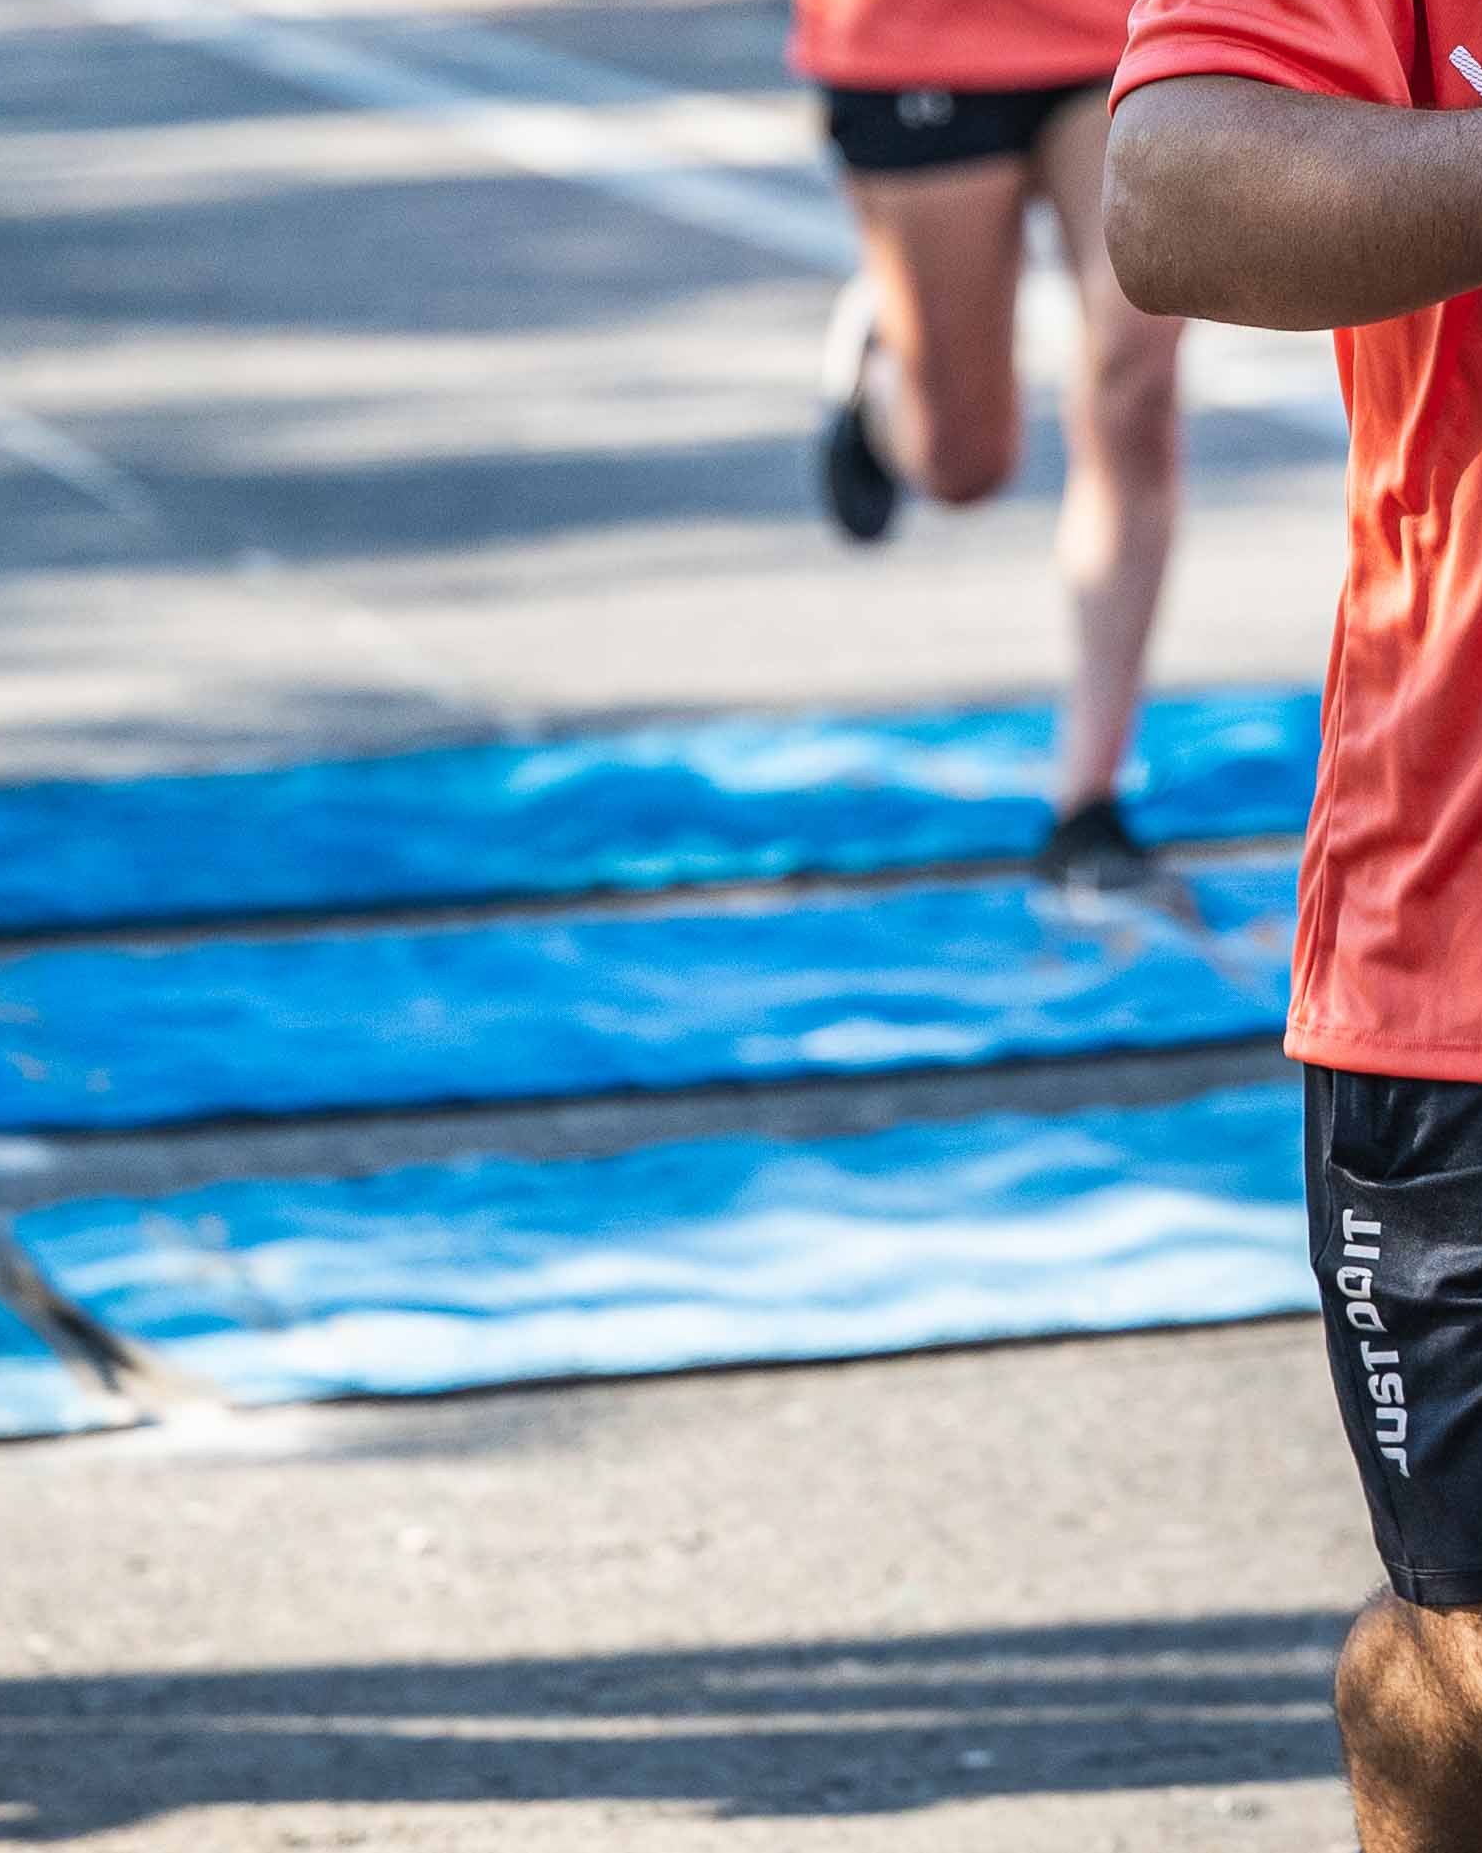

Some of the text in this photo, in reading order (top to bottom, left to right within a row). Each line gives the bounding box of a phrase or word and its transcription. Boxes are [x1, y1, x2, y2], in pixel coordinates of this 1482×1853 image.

[1336, 1208, 1411, 1478] JUST DO IT
